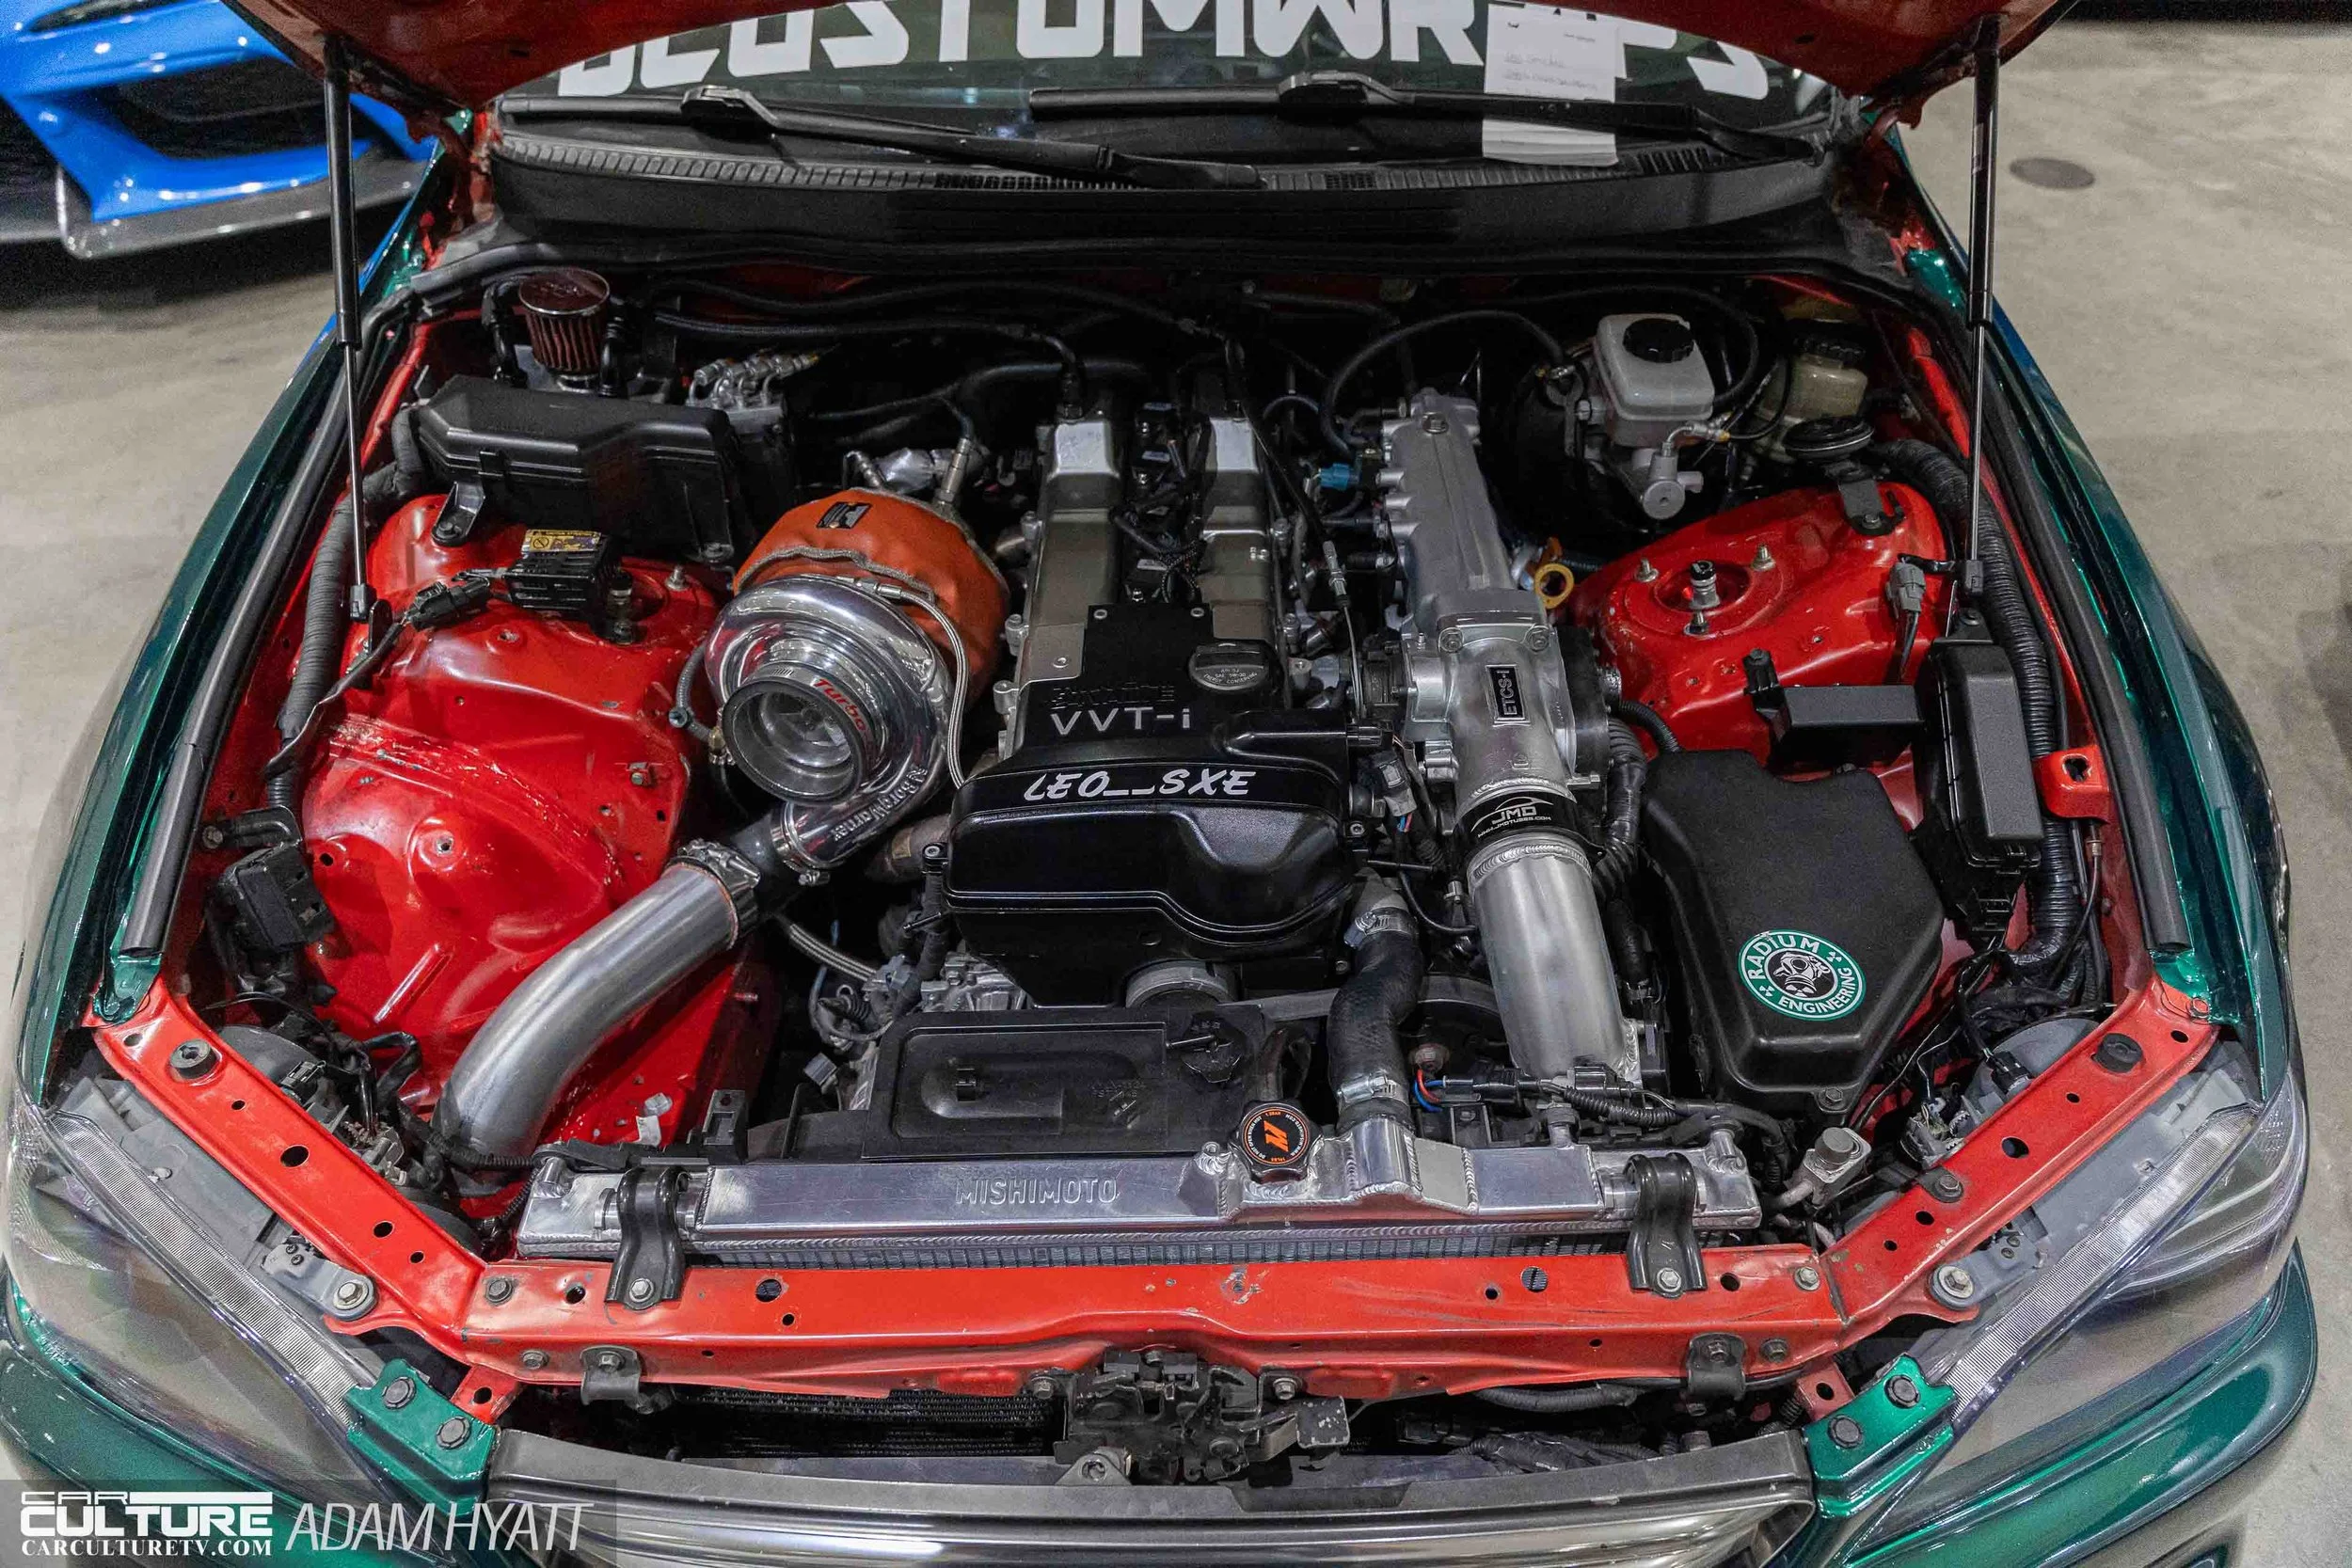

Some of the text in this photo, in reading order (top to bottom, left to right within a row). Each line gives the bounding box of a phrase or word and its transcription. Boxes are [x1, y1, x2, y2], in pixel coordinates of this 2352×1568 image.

[559, 0, 1769, 100] CUSTOMWRPS
[1050, 706, 1190, 736] VVT-i
[1747, 935, 1820, 979] RADIUM
[1778, 967, 1855, 1014] ENGINEERING
[956, 1177, 1119, 1206] MISHIMOTO
